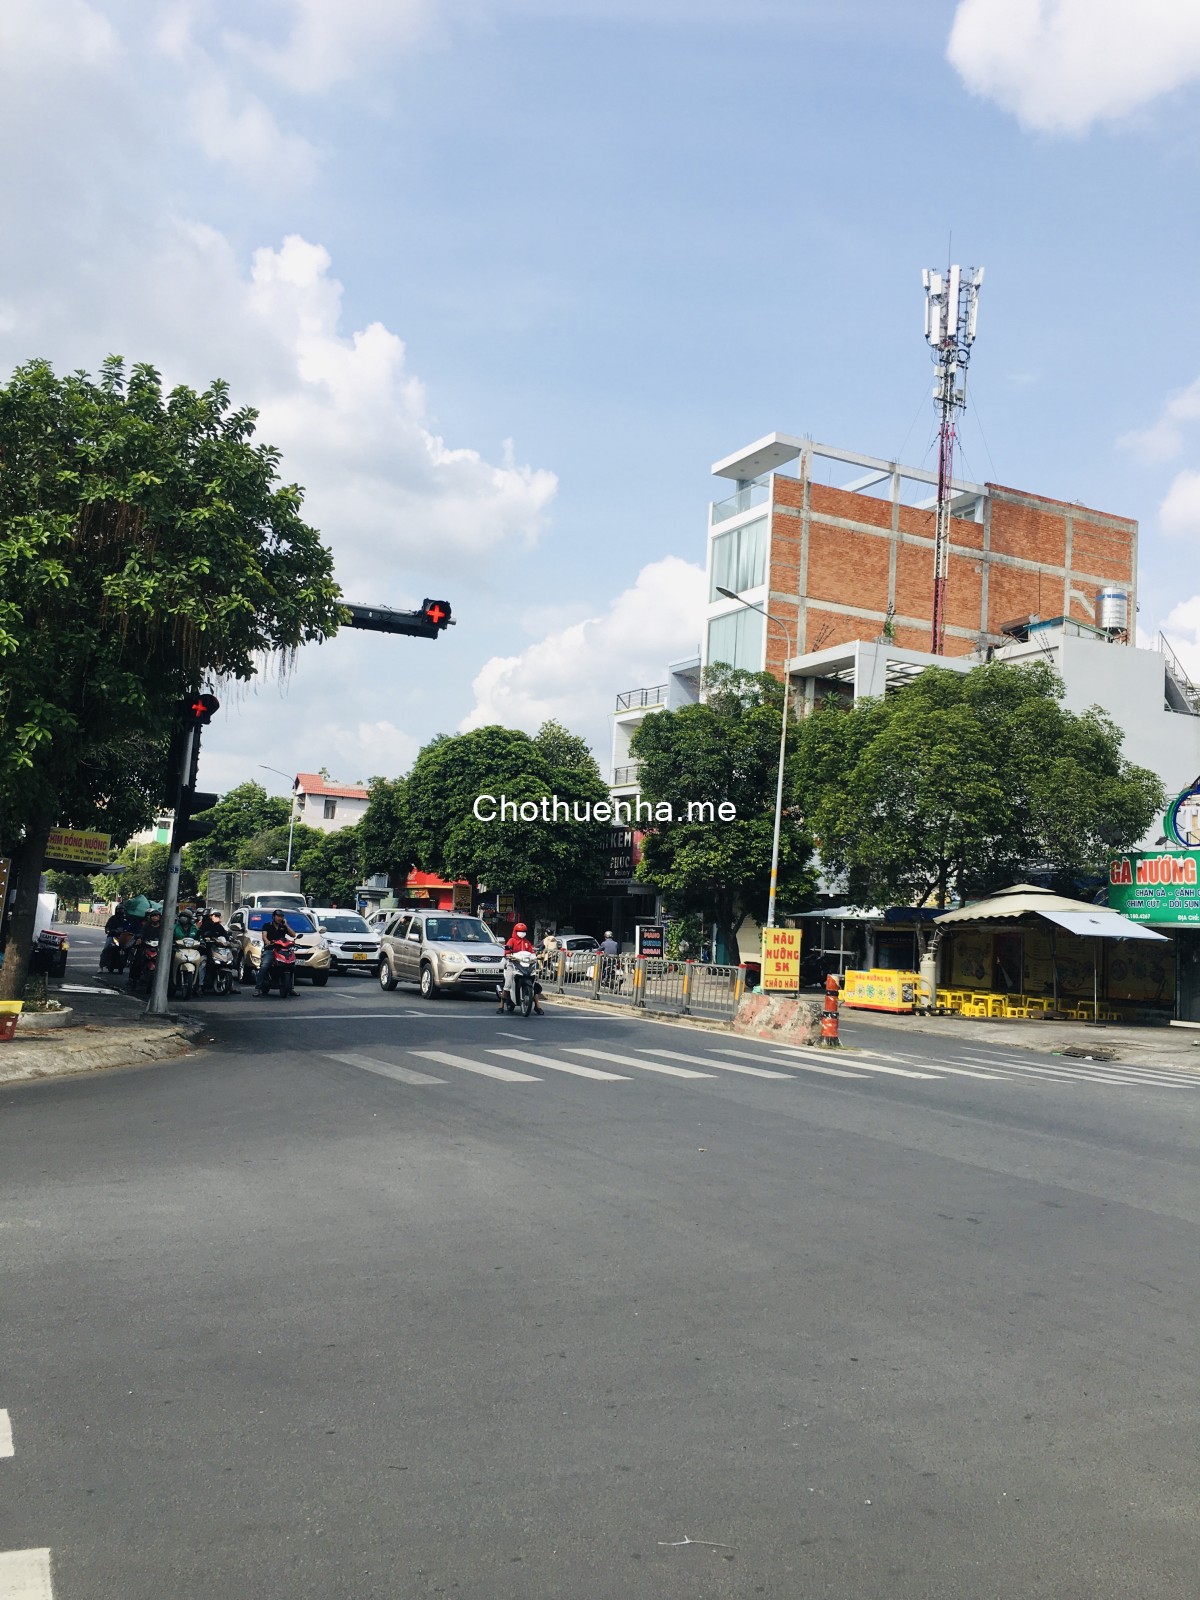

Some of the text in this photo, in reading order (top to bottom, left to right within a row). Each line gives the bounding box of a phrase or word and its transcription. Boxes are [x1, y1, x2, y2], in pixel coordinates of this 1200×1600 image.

[1110, 854, 1197, 886] GÀ NƯỚNG
[1135, 887, 1154, 897] CHÂN
[1156, 886, 1166, 897] GÀ
[1174, 886, 1195, 897] CÁNH
[1126, 900, 1144, 908] CHIM
[1146, 898, 1161, 908] CÚT
[773, 932, 794, 945] HÀU
